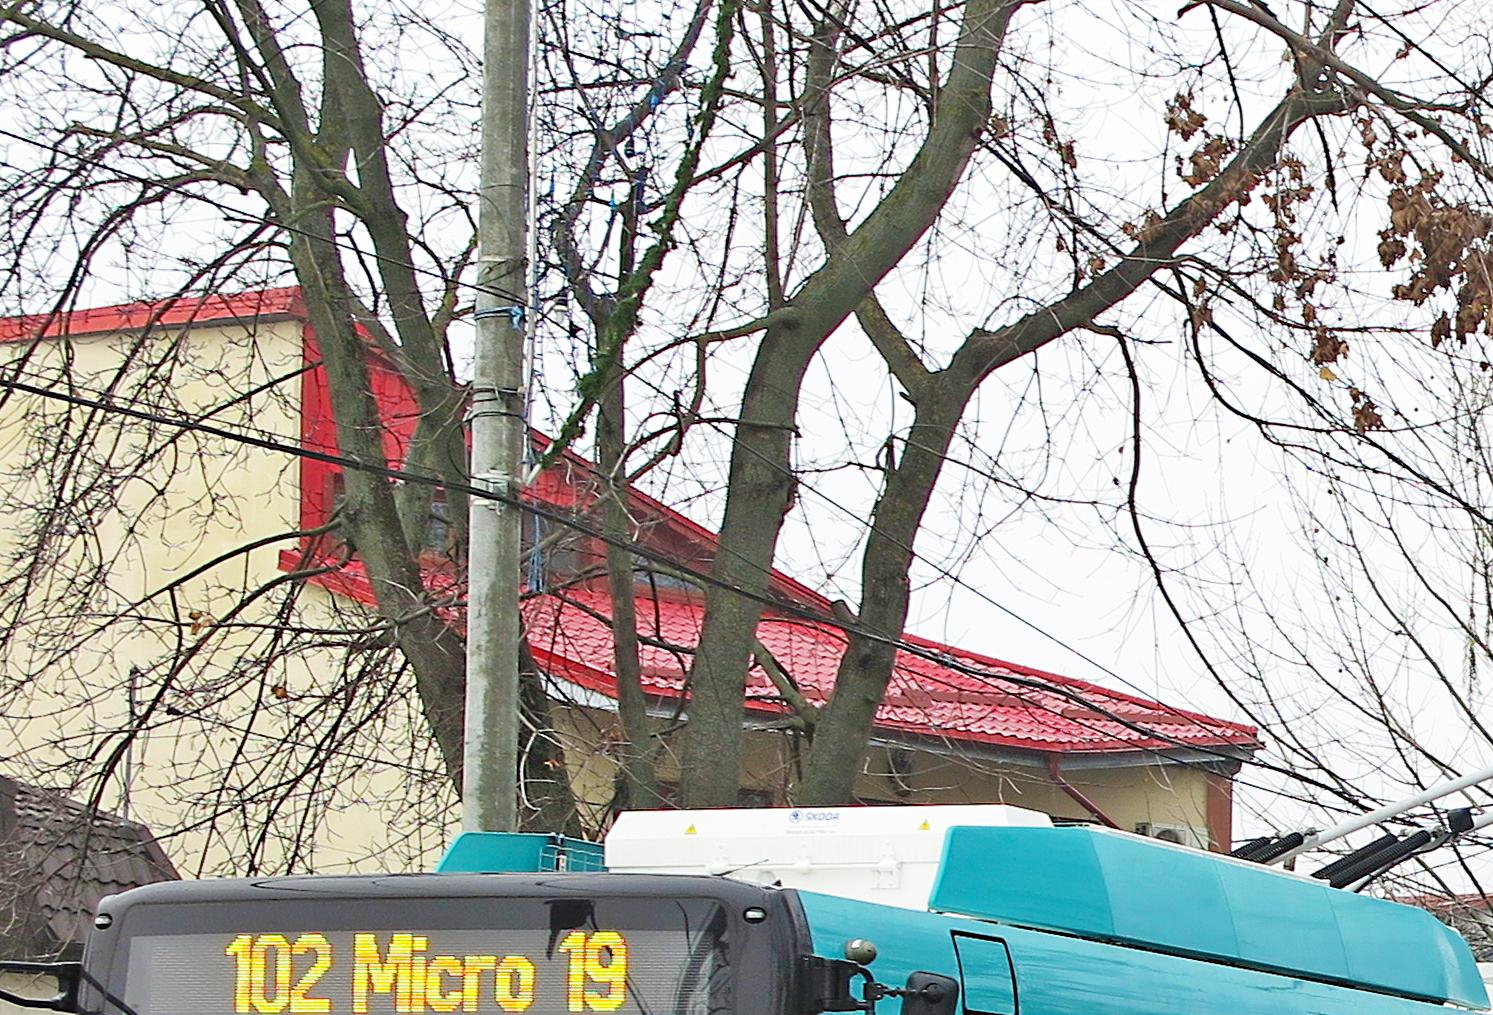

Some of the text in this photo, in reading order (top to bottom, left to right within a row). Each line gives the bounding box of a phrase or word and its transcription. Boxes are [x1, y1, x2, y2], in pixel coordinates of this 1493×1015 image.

[225, 930, 628, 1014] 102 Micro 19
